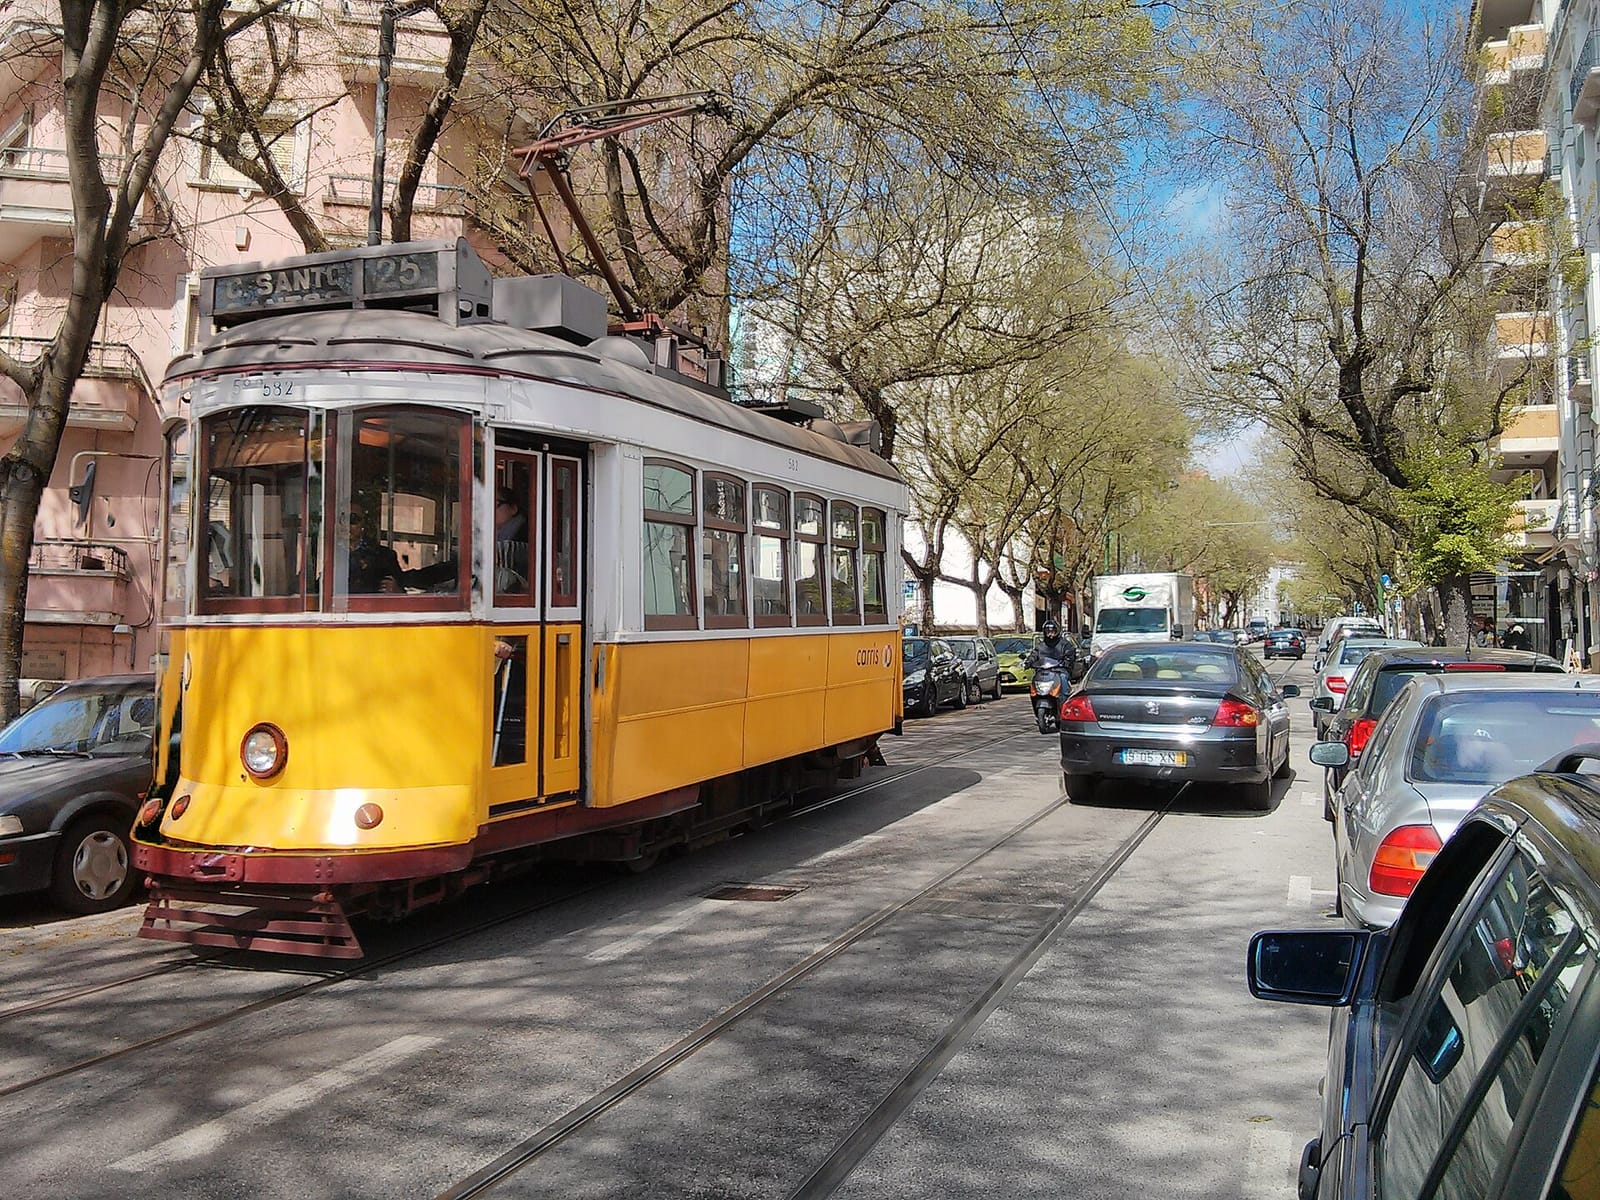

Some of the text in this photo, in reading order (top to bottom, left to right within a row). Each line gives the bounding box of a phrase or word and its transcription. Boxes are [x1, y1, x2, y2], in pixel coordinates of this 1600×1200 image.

[375, 256, 421, 290] 25
[263, 381, 293, 397] 582
[856, 641, 879, 666] carris
